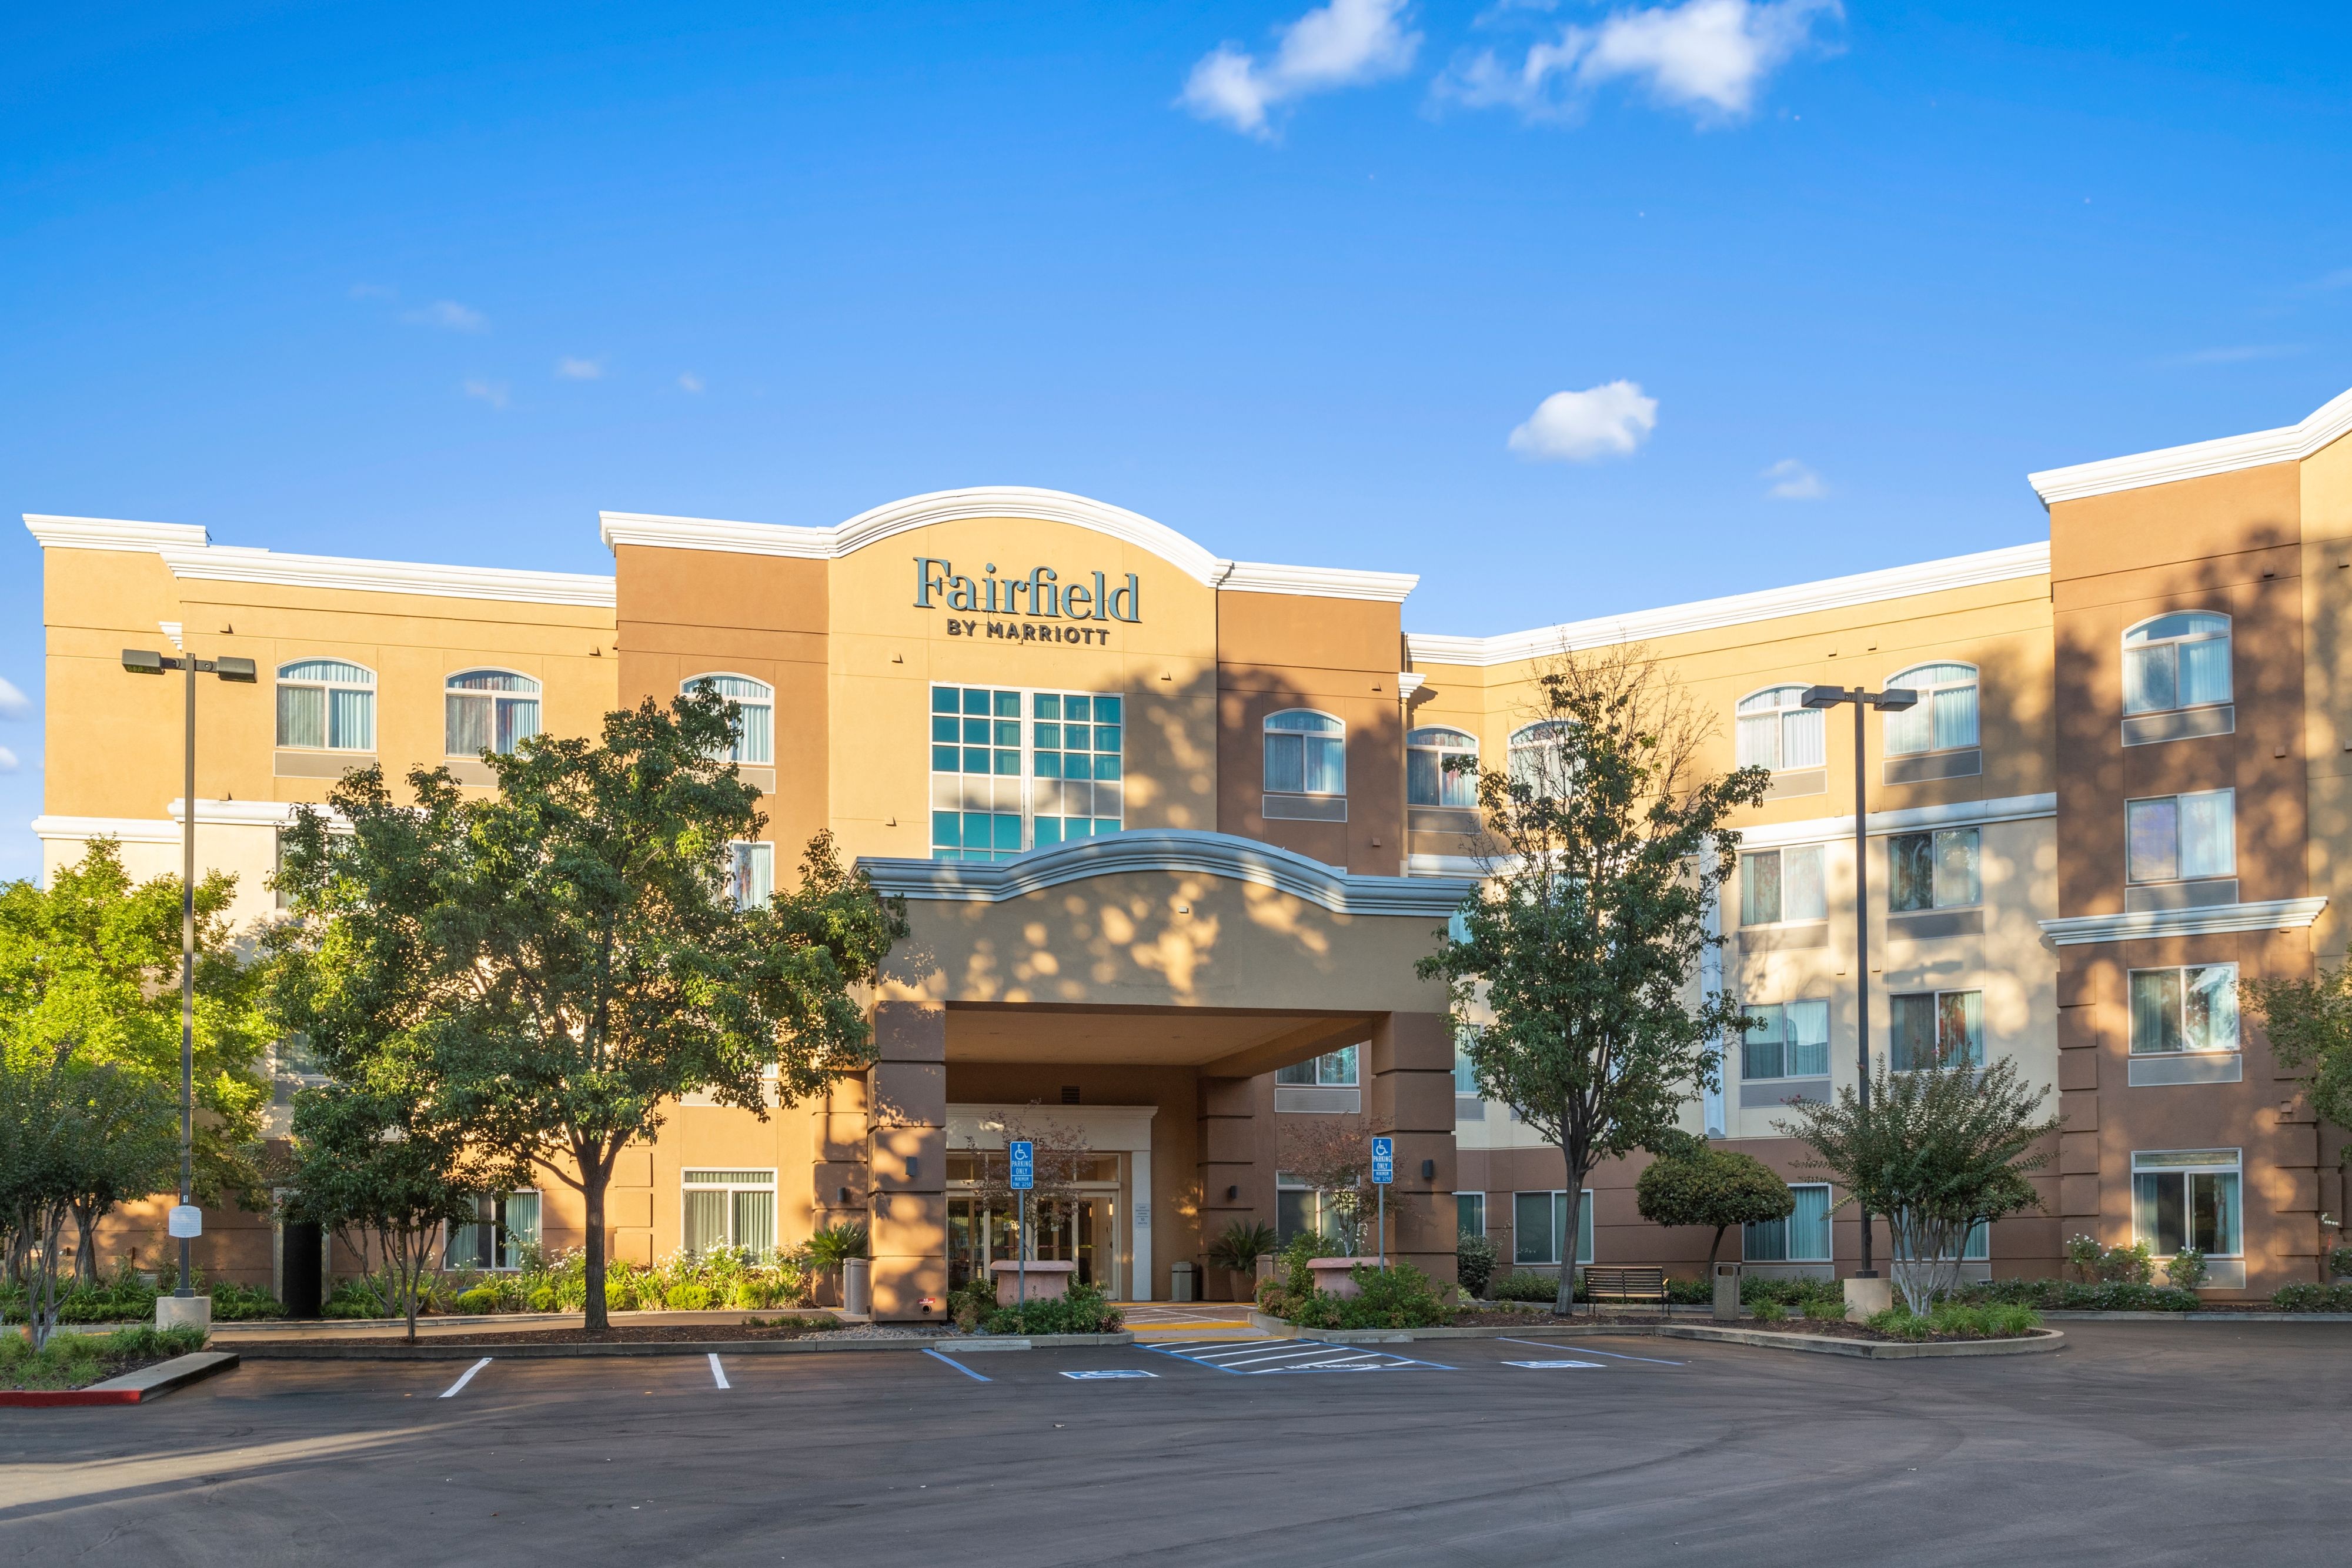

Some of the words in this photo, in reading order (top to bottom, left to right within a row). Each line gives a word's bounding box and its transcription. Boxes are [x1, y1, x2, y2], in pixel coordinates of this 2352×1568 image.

[913, 557, 1142, 623] Fairfield
[947, 618, 975, 637] BY
[987, 621, 1110, 646] MARRIOTT
